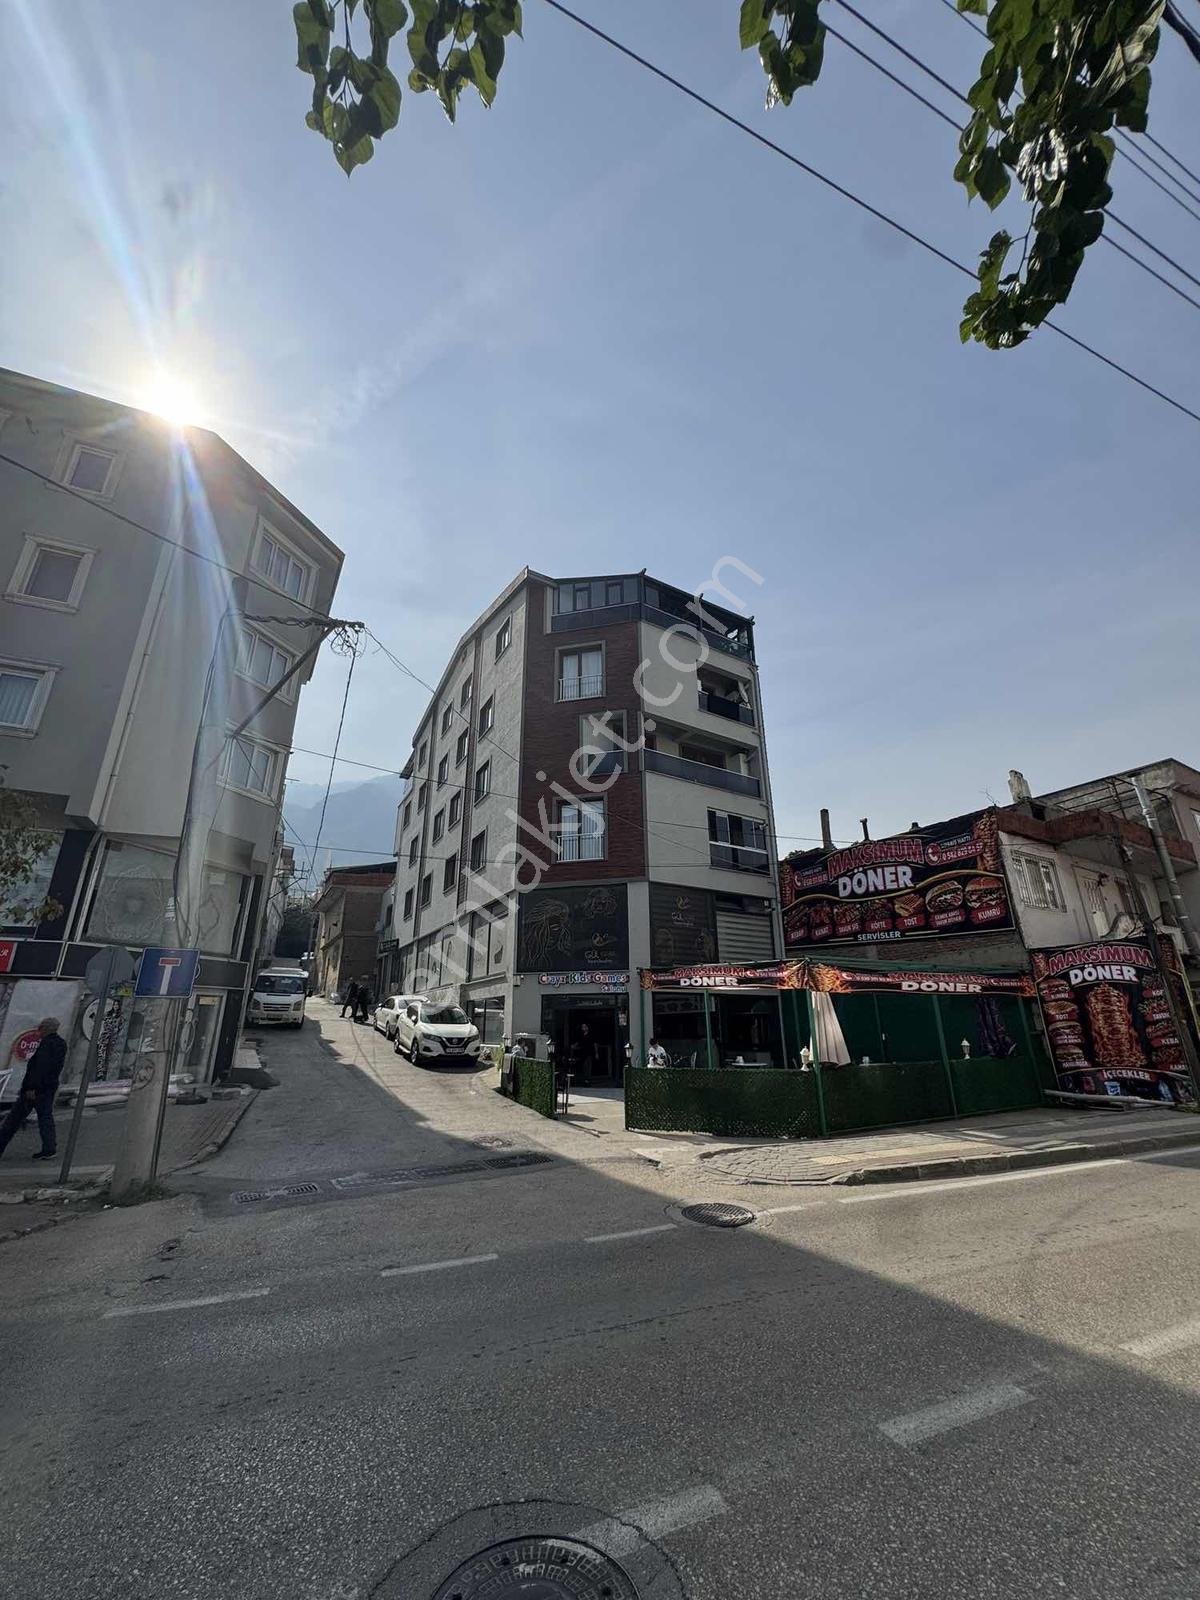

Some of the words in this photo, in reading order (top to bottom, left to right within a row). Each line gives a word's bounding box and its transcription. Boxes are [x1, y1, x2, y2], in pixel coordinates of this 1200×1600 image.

[838, 865, 914, 897] DÖNER
[977, 907, 1001, 920] KUMRU
[857, 931, 901, 941] SERVİSLER
[1049, 943, 1154, 975] MAKSİMUM
[568, 971, 591, 984] Kids
[592, 972, 629, 984] Games
[680, 975, 739, 986] DÖNER
[1069, 963, 1139, 985] DÖNER
[901, 979, 982, 992] DÖNER
